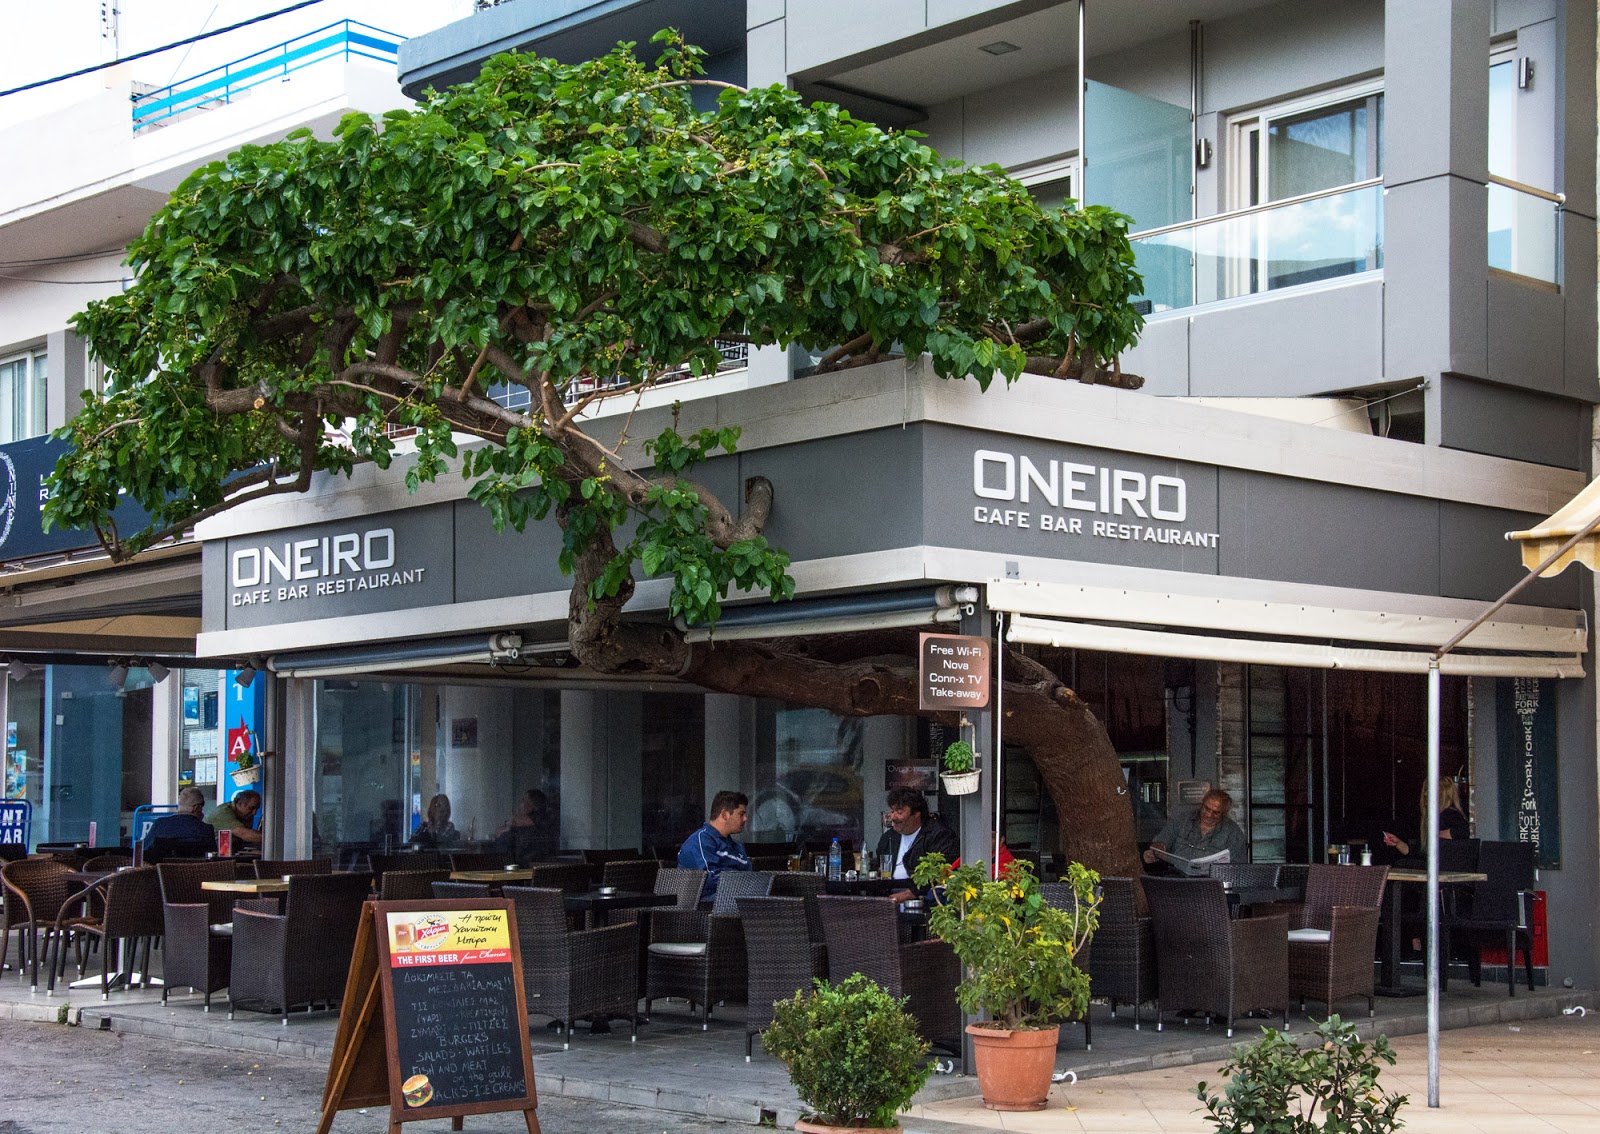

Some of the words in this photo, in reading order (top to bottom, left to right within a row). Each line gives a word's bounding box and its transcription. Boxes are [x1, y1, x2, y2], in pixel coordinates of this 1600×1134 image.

[973, 449, 1187, 522] ONEIRO
[973, 506, 1030, 529] CAFE
[1040, 514, 1082, 534] BAR
[1093, 520, 1220, 548] RESTAURANT
[232, 527, 395, 588] ONEIRO
[232, 589, 271, 606] CAFE
[277, 584, 308, 601] BAR
[316, 568, 425, 596] RESTAURANT
[930, 644, 954, 655] Free
[956, 646, 982, 657] Wi-Fi
[943, 659, 969, 670] Nova
[929, 672, 965, 684] Conn-x
[967, 675, 982, 685] TV
[930, 686, 981, 700] Take-away
[1515, 700, 1539, 709] FORK
[1525, 727, 1534, 756] FORK
[0, 809, 24, 827] NT
[0, 828, 23, 845] AR
[397, 956, 414, 965] THE
[414, 955, 436, 964] FIRST
[437, 954, 458, 963] BEER
[460, 952, 477, 965] from
[479, 948, 506, 958] Chania
[416, 1050, 456, 1063] SALADS
[411, 1064, 435, 1076] FISH
[438, 1063, 458, 1074] AND
[462, 1060, 487, 1072] MEAT
